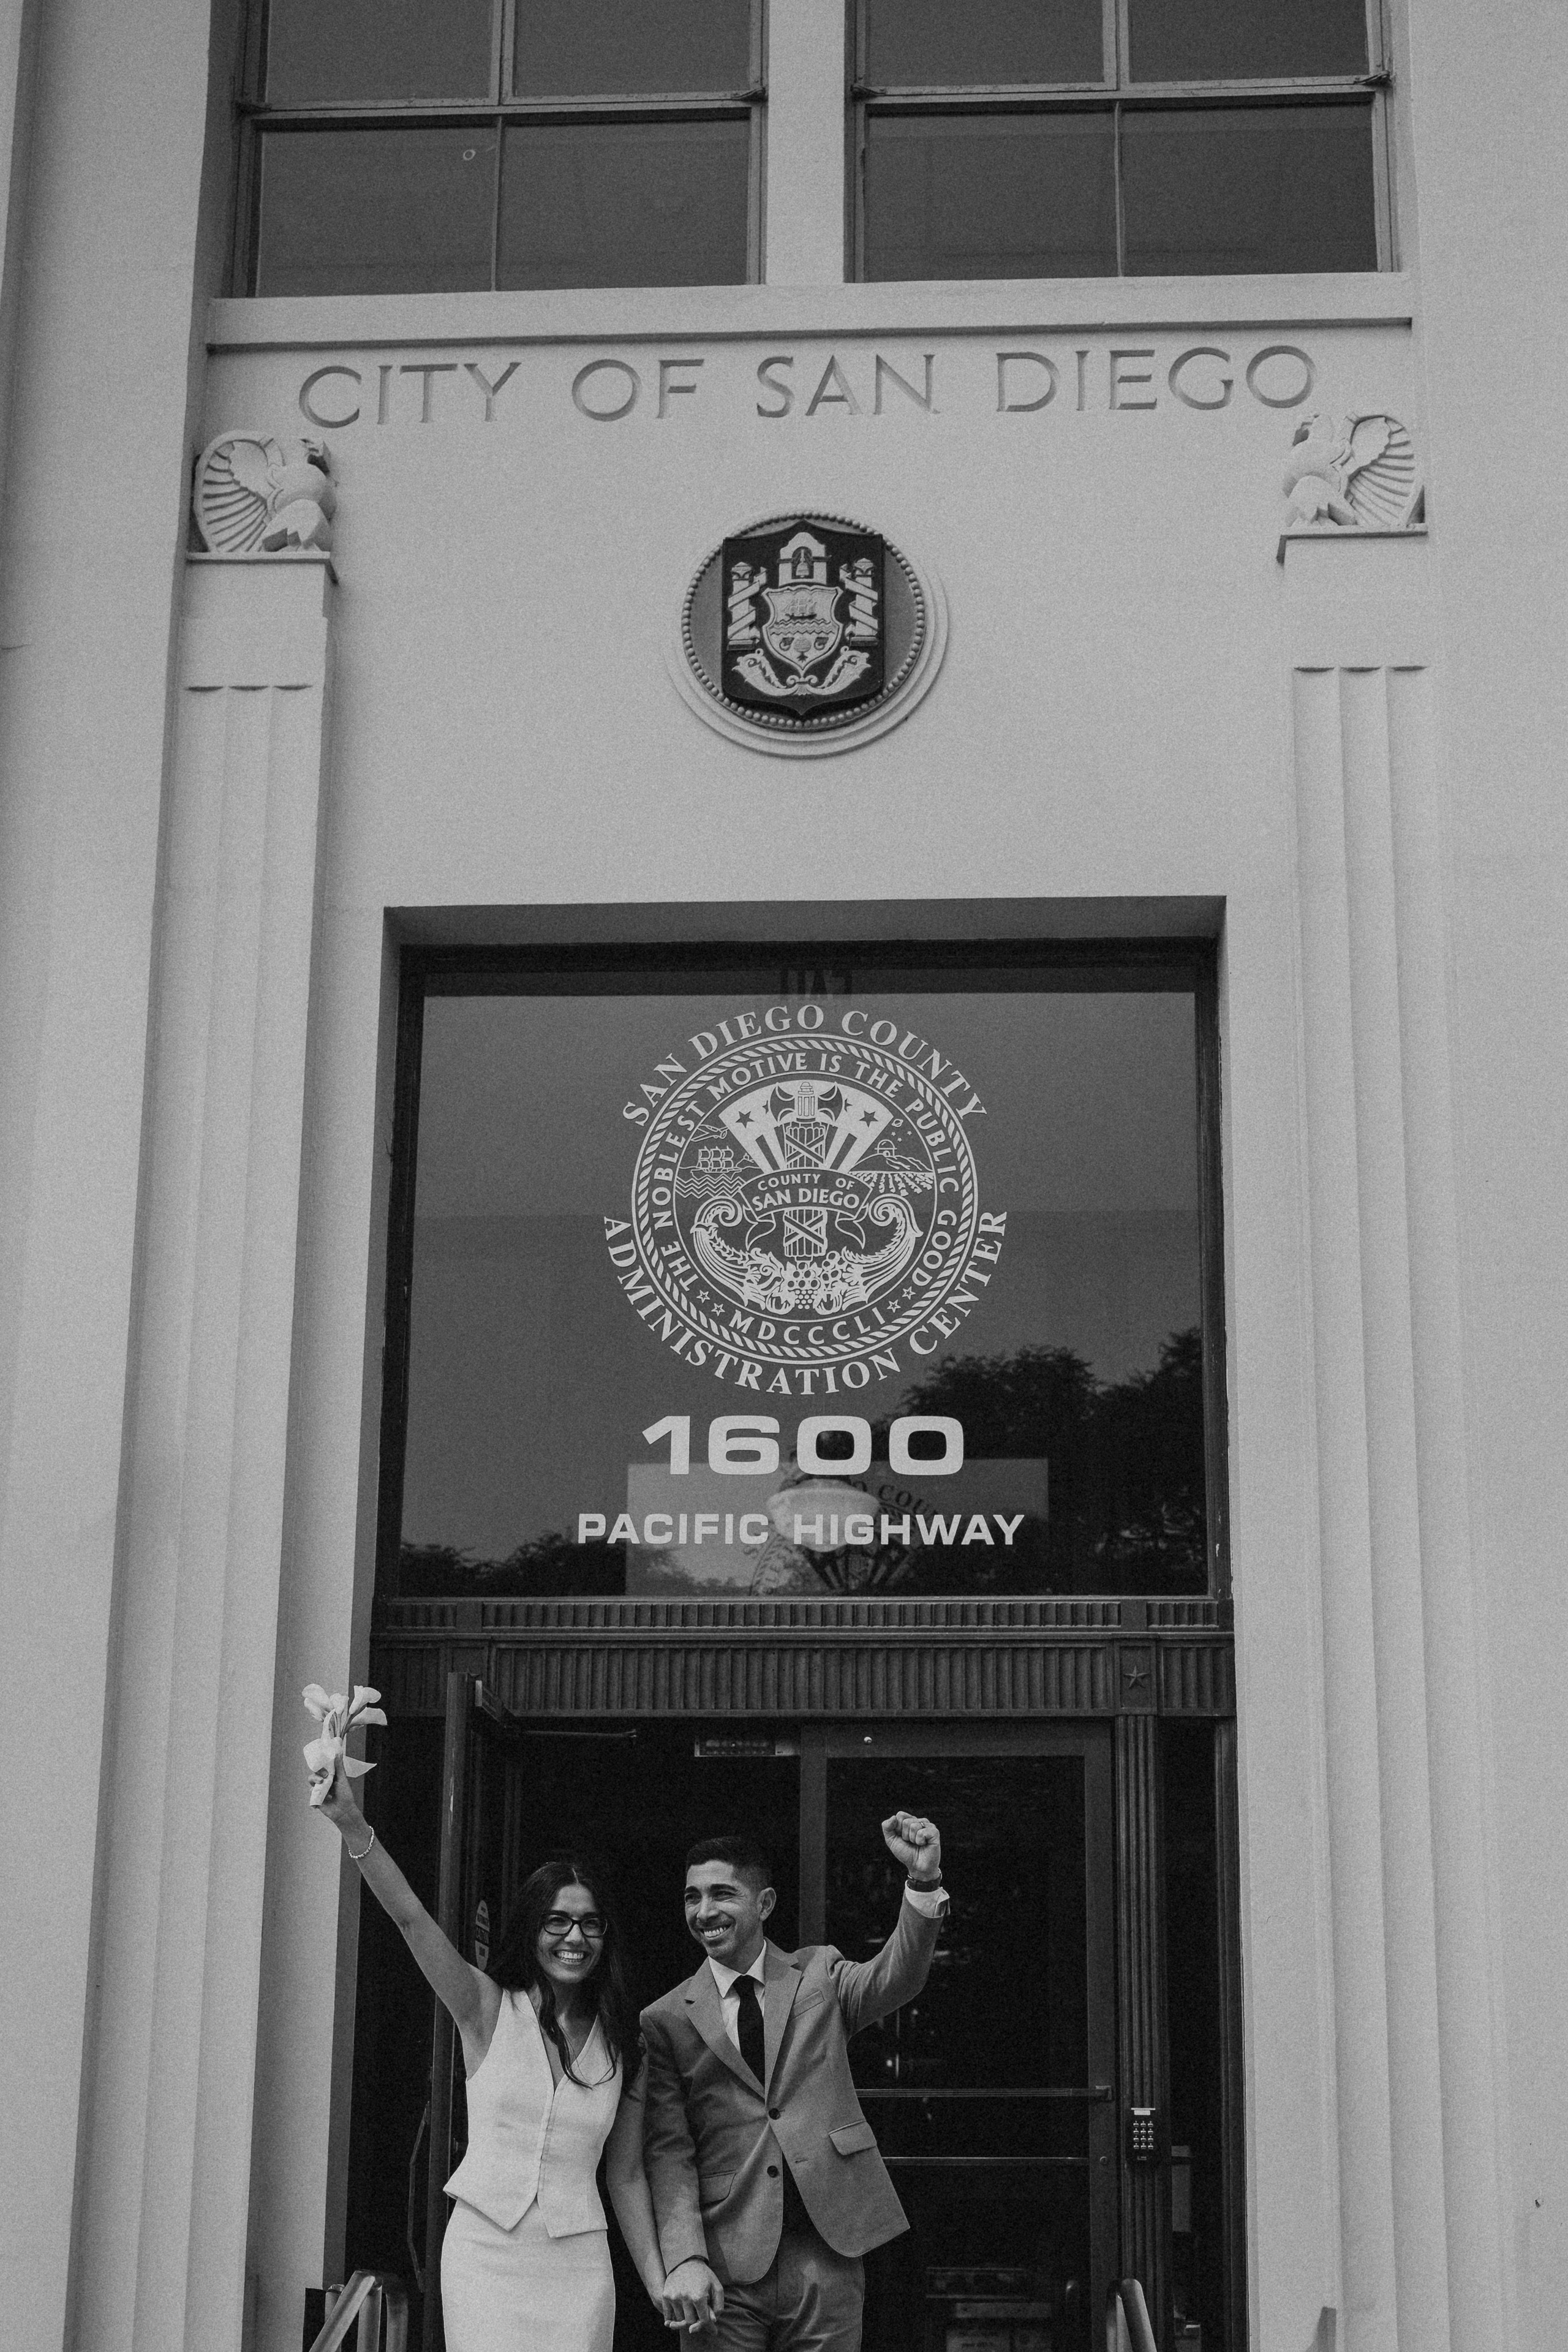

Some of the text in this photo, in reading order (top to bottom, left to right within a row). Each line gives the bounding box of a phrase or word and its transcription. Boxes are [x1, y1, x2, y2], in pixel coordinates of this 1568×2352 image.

[299, 345, 1316, 428] CITY OF SAN DIEGO
[622, 1004, 987, 1126] SAN DIEGO COUNTY
[652, 1052, 959, 1291] THE NOBLEST MOTIVE IS THE PUBLIC GOOD
[752, 1188, 860, 1212] SAN DIEGO
[757, 1174, 855, 1191] COUNTY OF
[603, 1211, 1008, 1395] ADMINISTRATION CENTER
[728, 1307, 886, 1345] MDCCCLI
[642, 1415, 964, 1476] 1600
[578, 1513, 1025, 1545] PACIFIC HIGHWAY
